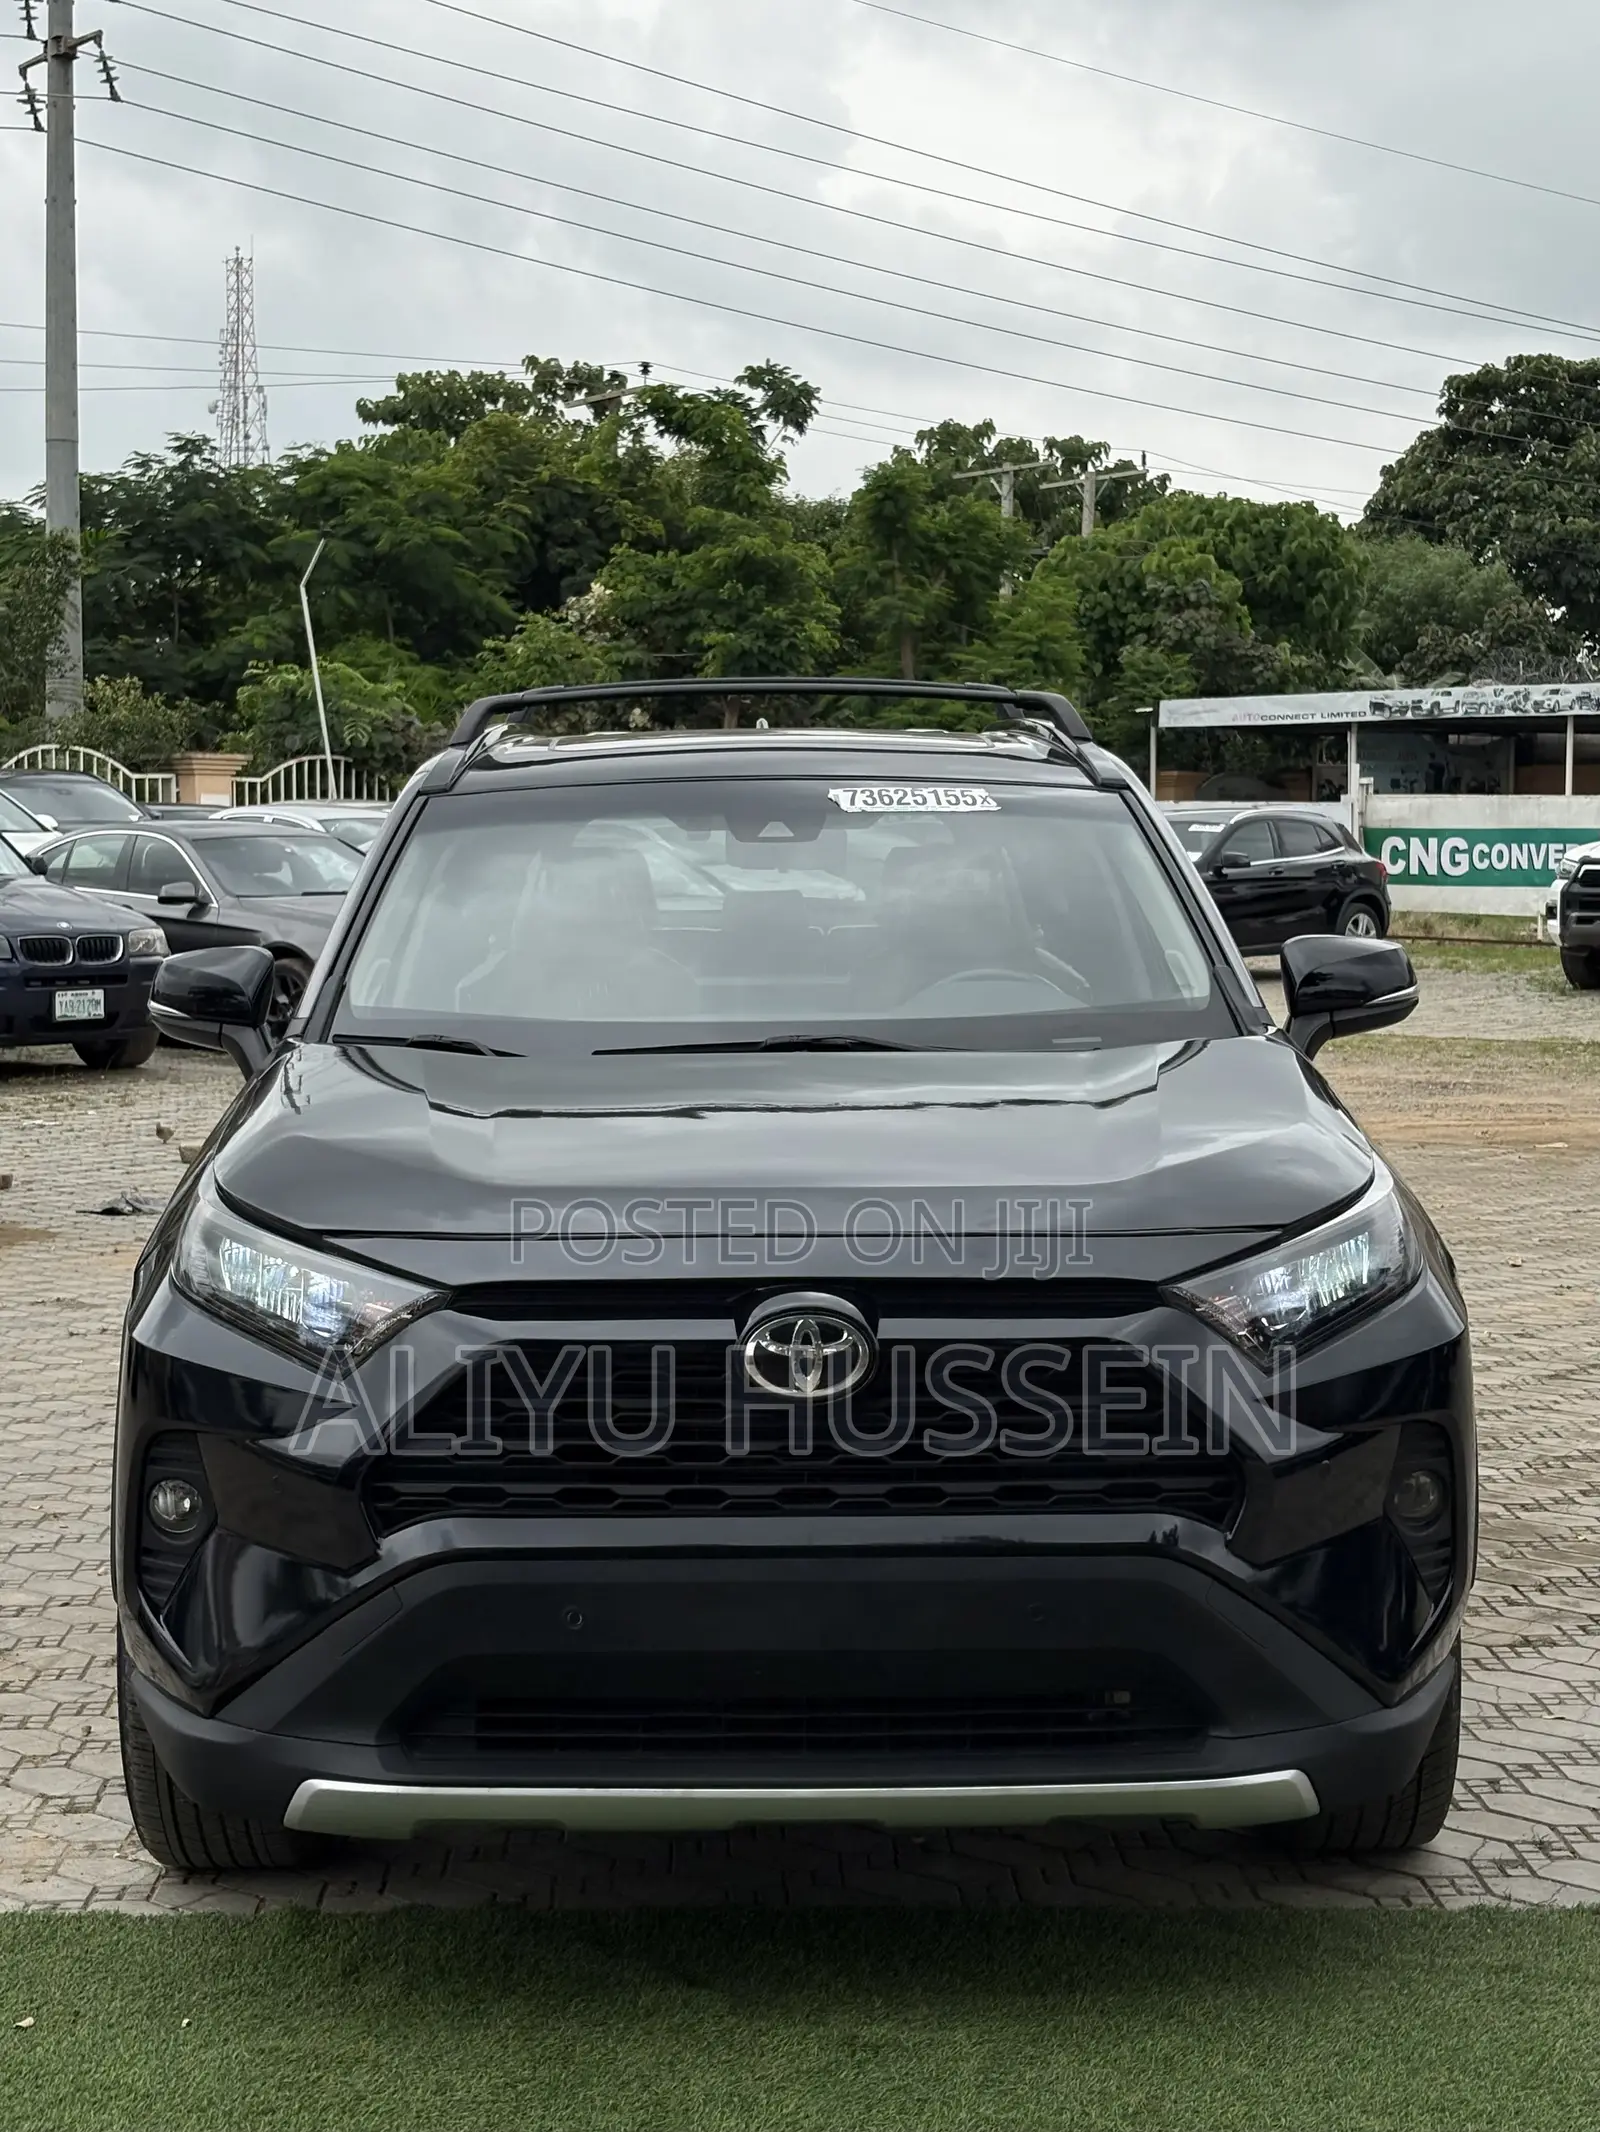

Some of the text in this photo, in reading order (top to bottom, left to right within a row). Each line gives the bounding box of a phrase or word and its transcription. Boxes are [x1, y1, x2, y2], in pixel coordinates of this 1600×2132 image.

[1320, 710, 1367, 719] LIMITED
[1381, 836, 1579, 877] CNG CONVE
